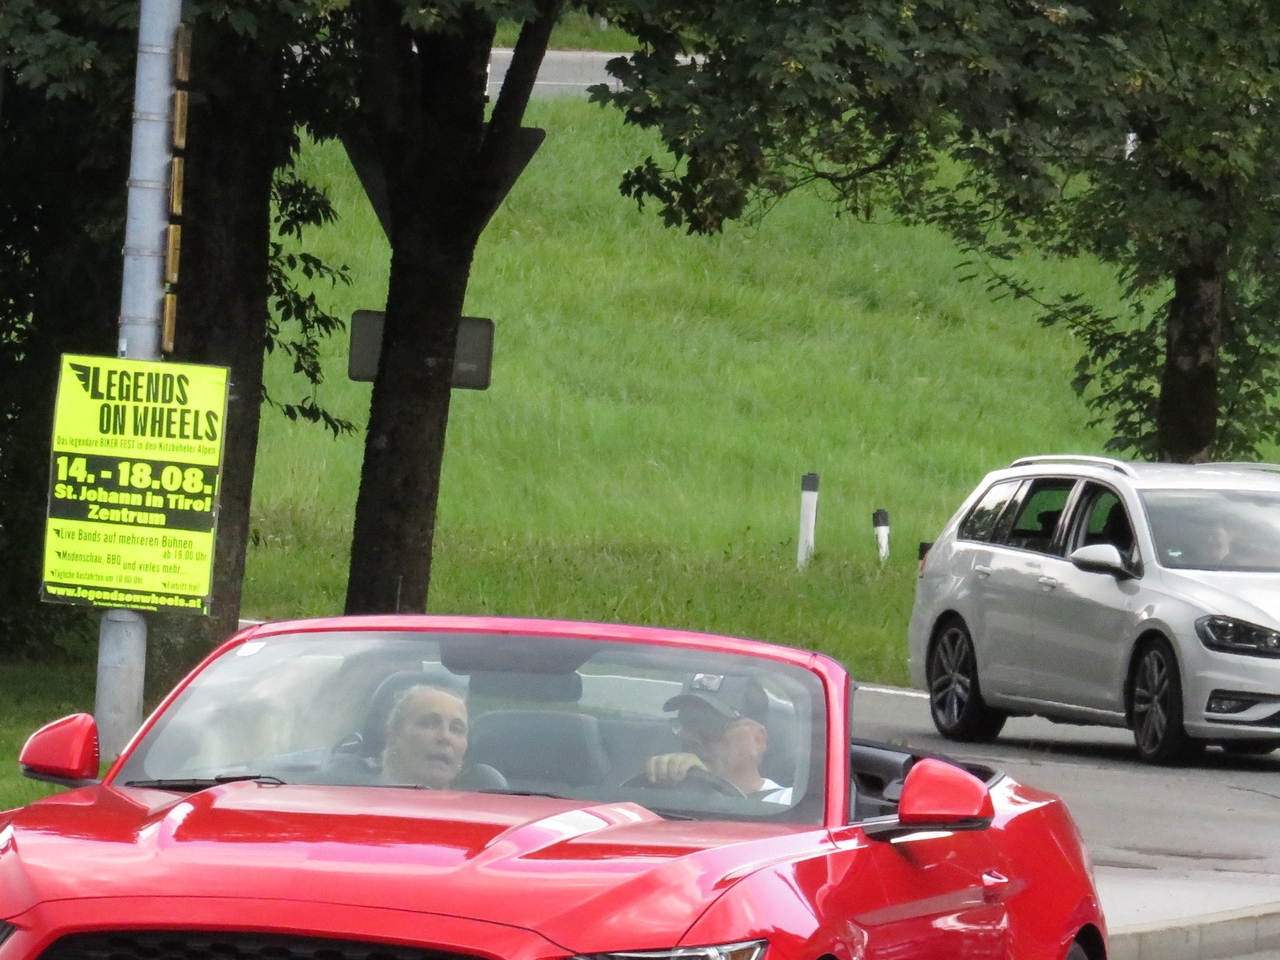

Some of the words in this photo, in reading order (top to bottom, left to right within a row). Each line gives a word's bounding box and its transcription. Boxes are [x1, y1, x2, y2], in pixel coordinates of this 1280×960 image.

[90, 366, 190, 406] LEGENDS
[99, 403, 126, 435] ON
[133, 405, 219, 442] WHEELS
[57, 435, 68, 446] Das
[100, 437, 118, 448] BIKER
[120, 439, 135, 449] FEST
[145, 441, 157, 450] den
[197, 443, 216, 455] Alpen
[56, 455, 95, 484] 14.
[118, 461, 212, 494] 18.08.
[54, 483, 77, 499] St.
[79, 486, 142, 508] Johann
[145, 491, 164, 508] in
[167, 494, 212, 512] Tirol
[87, 504, 166, 526] Zentrum
[60, 527, 75, 540] Live
[78, 529, 101, 543] Bands
[103, 531, 117, 543] auf
[118, 533, 159, 547] mehreren
[162, 535, 193, 549] Bühnen
[61, 550, 104, 565] Modenschau,
[107, 554, 121, 565] BBQ
[163, 549, 171, 559] ab
[174, 550, 193, 560] 19.00
[196, 551, 207, 561] Uhr
[123, 561, 136, 571] und
[139, 561, 160, 573] vieles
[134, 575, 143, 584] Uhr
[167, 581, 187, 591] Eintritt
[46, 585, 202, 608] www.legendsonwheels.at
